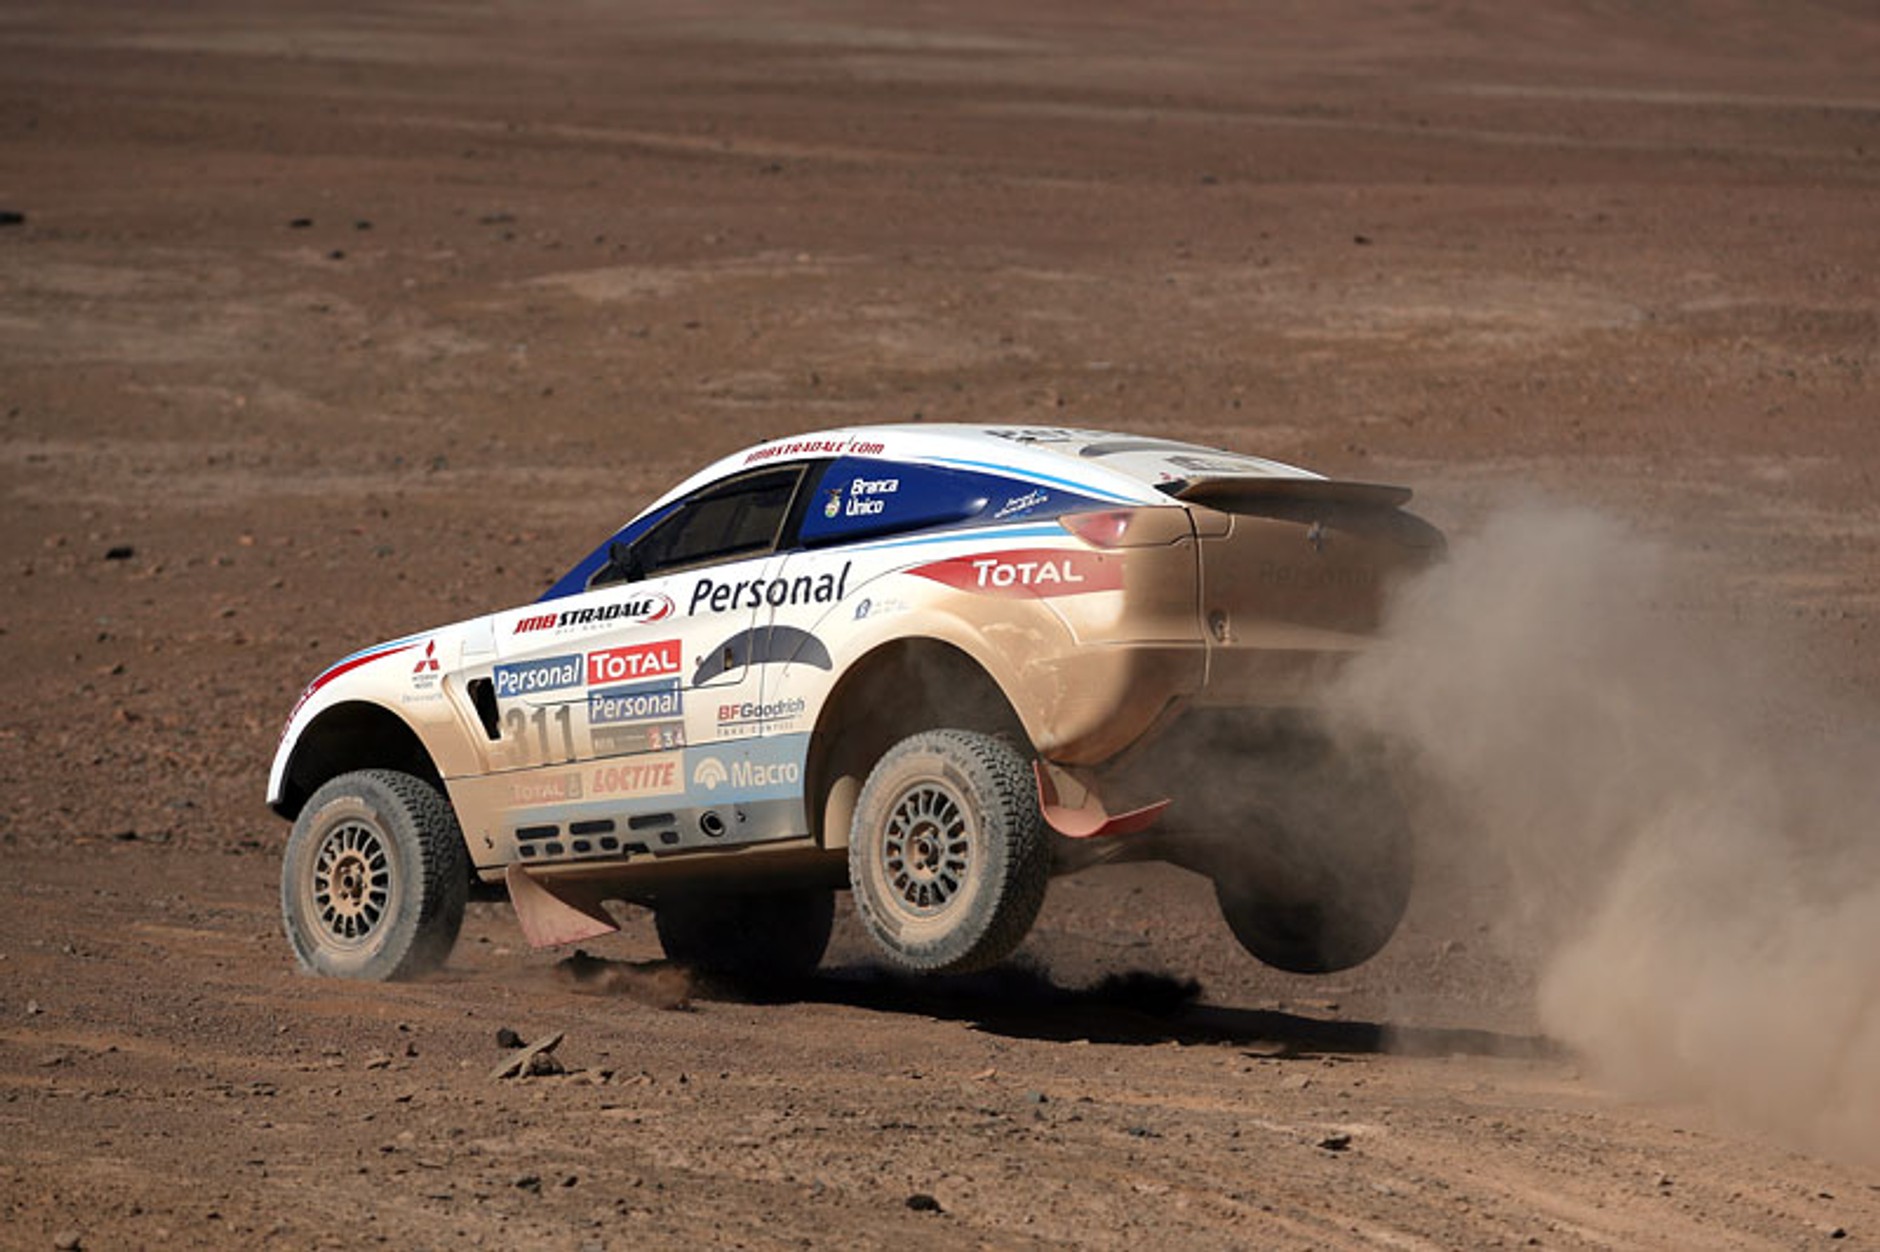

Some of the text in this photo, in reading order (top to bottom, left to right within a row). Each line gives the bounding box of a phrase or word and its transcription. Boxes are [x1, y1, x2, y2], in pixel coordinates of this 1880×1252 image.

[688, 561, 852, 617] Personal
[973, 559, 1083, 588] TOTAL
[512, 613, 558, 635] JMB
[557, 599, 654, 627] STRADALE
[496, 657, 580, 695] Personal
[591, 649, 678, 680] TOTAL
[591, 682, 678, 721] Personal
[718, 697, 805, 721] BFGoodrich
[506, 705, 577, 765] 311
[593, 762, 675, 793] LOCTITE
[731, 761, 799, 788] Macro
